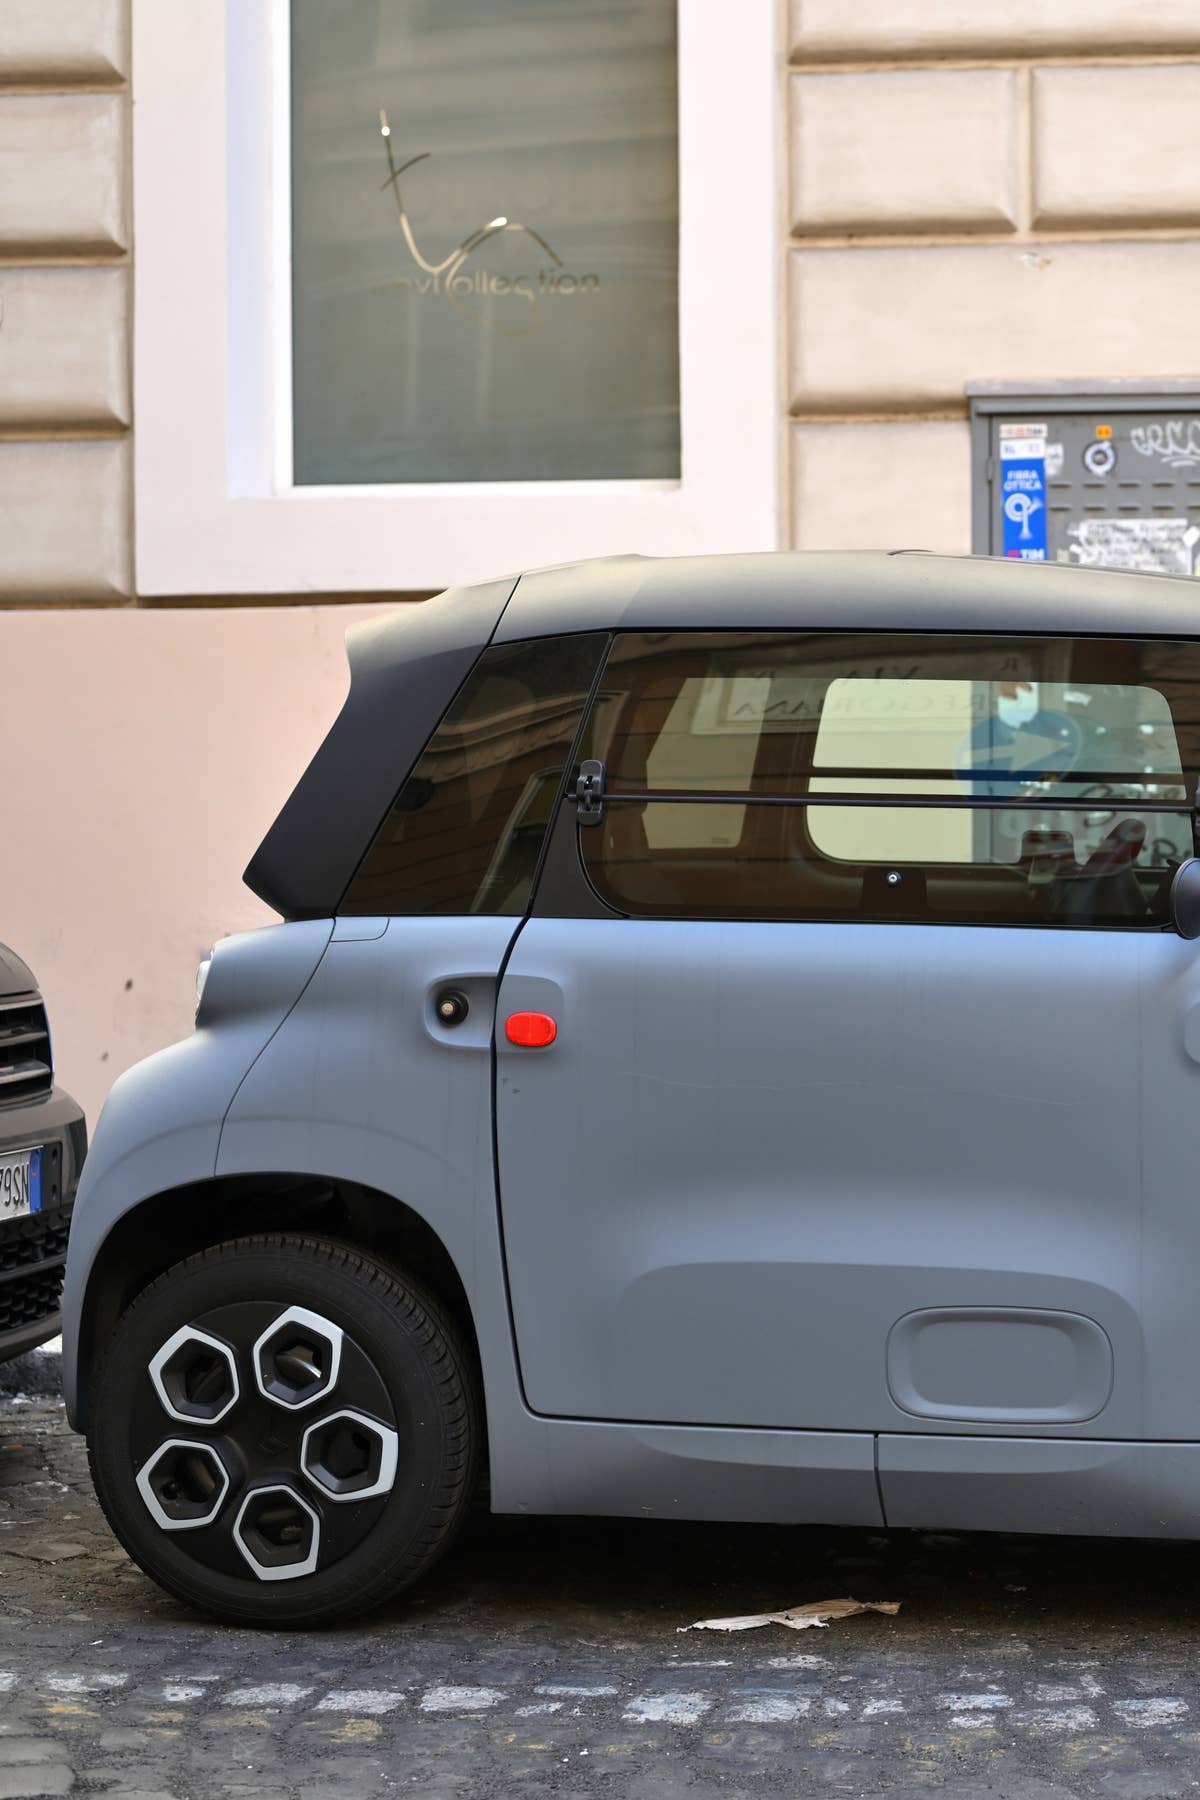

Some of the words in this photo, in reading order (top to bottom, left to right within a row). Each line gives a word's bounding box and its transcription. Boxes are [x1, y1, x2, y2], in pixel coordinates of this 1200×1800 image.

[1007, 469, 1039, 480] FIBRA
[1003, 480, 1043, 491] OTTICA
[1020, 548, 1045, 561] TIM
